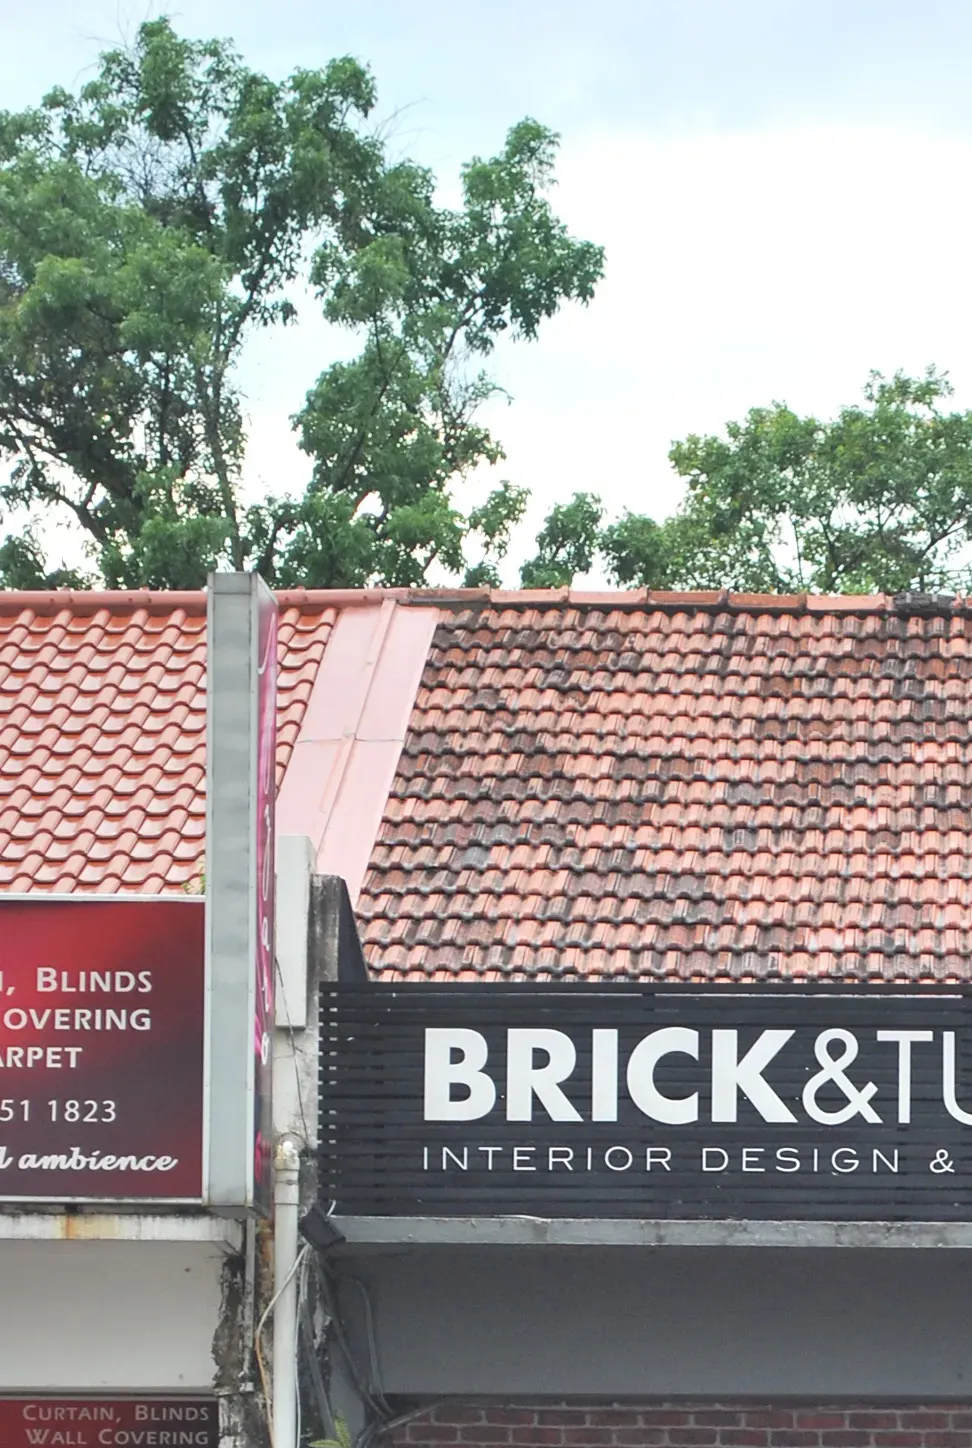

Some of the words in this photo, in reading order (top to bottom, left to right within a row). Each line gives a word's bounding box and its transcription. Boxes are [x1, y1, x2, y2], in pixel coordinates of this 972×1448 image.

[36, 967, 152, 993] BLINDS
[0, 1008, 152, 1031] OVERING
[47, 1100, 117, 1122] 1823
[18, 1146, 179, 1172] ambience
[422, 1146, 672, 1174] INTERIOR
[702, 1146, 899, 1175] DESIGN
[930, 1147, 956, 1176] &
[22, 1405, 122, 1423] CURTAIN,
[135, 1405, 209, 1421] BLINDS
[25, 1429, 87, 1445] WALL
[98, 1429, 209, 1445] COVERING
